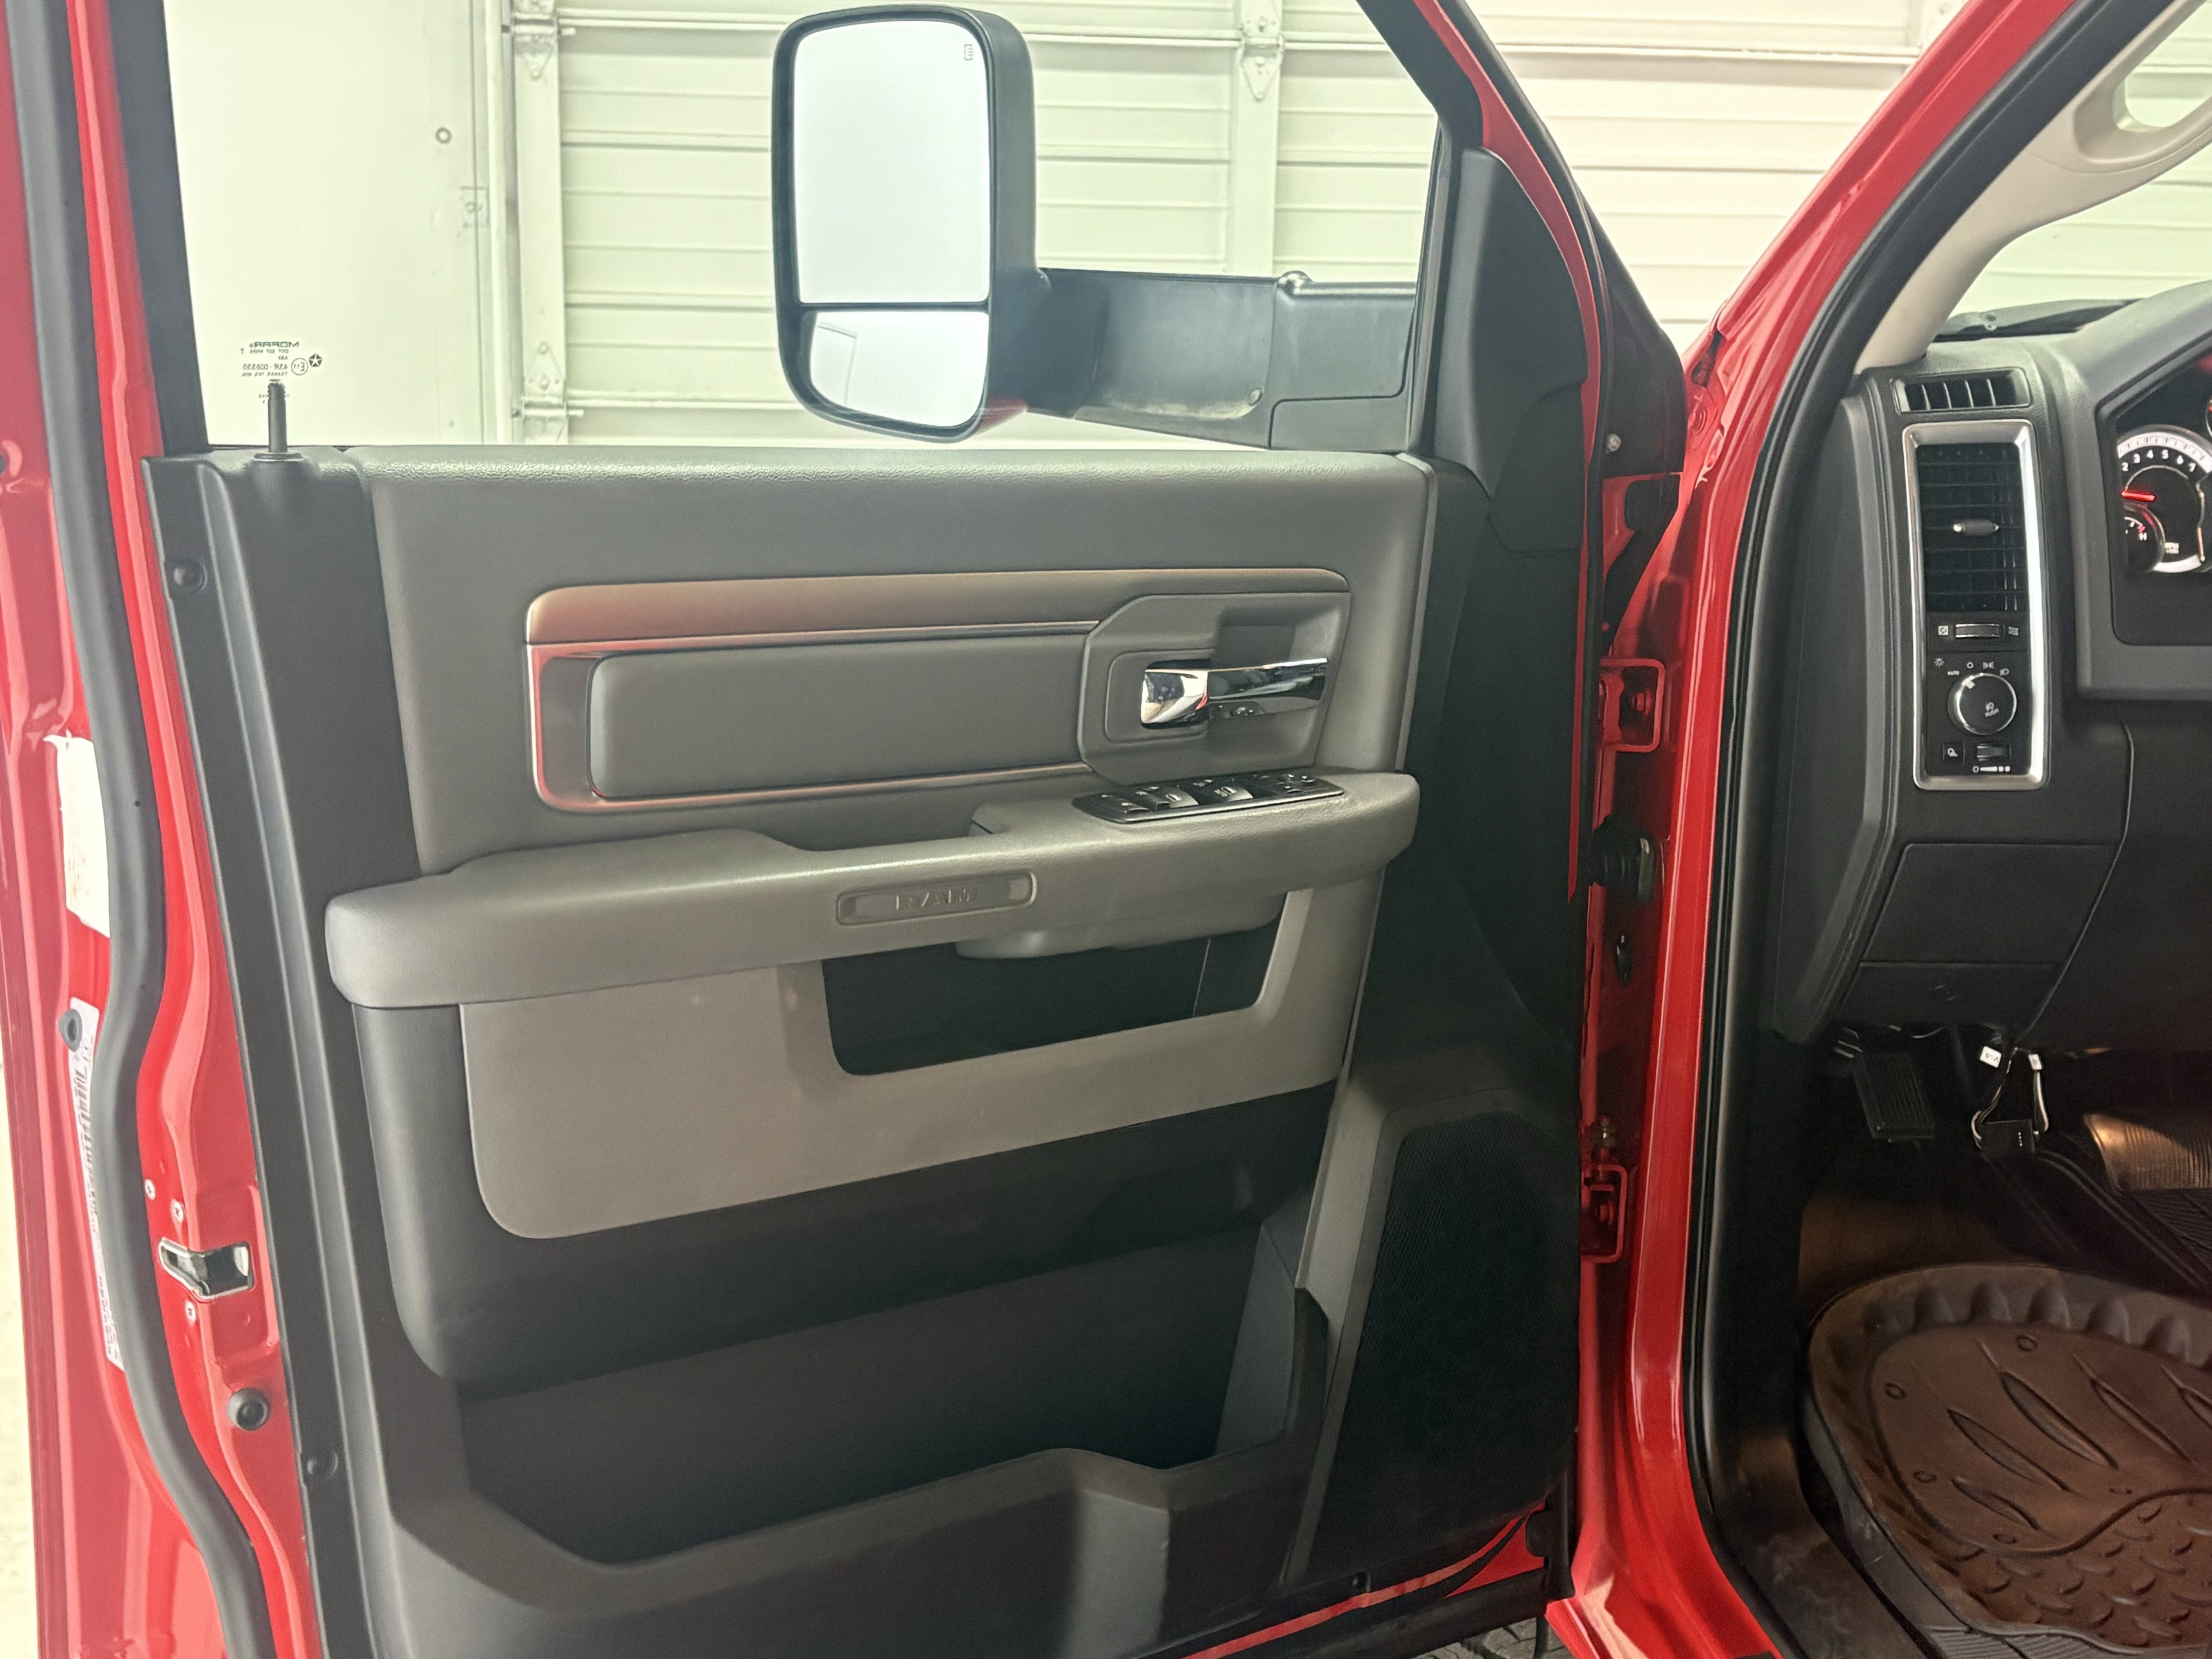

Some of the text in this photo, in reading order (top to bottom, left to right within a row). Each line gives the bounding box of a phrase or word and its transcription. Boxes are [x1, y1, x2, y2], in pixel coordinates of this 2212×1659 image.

[2122, 449, 2196, 472] 2 3 4 5 6 7
